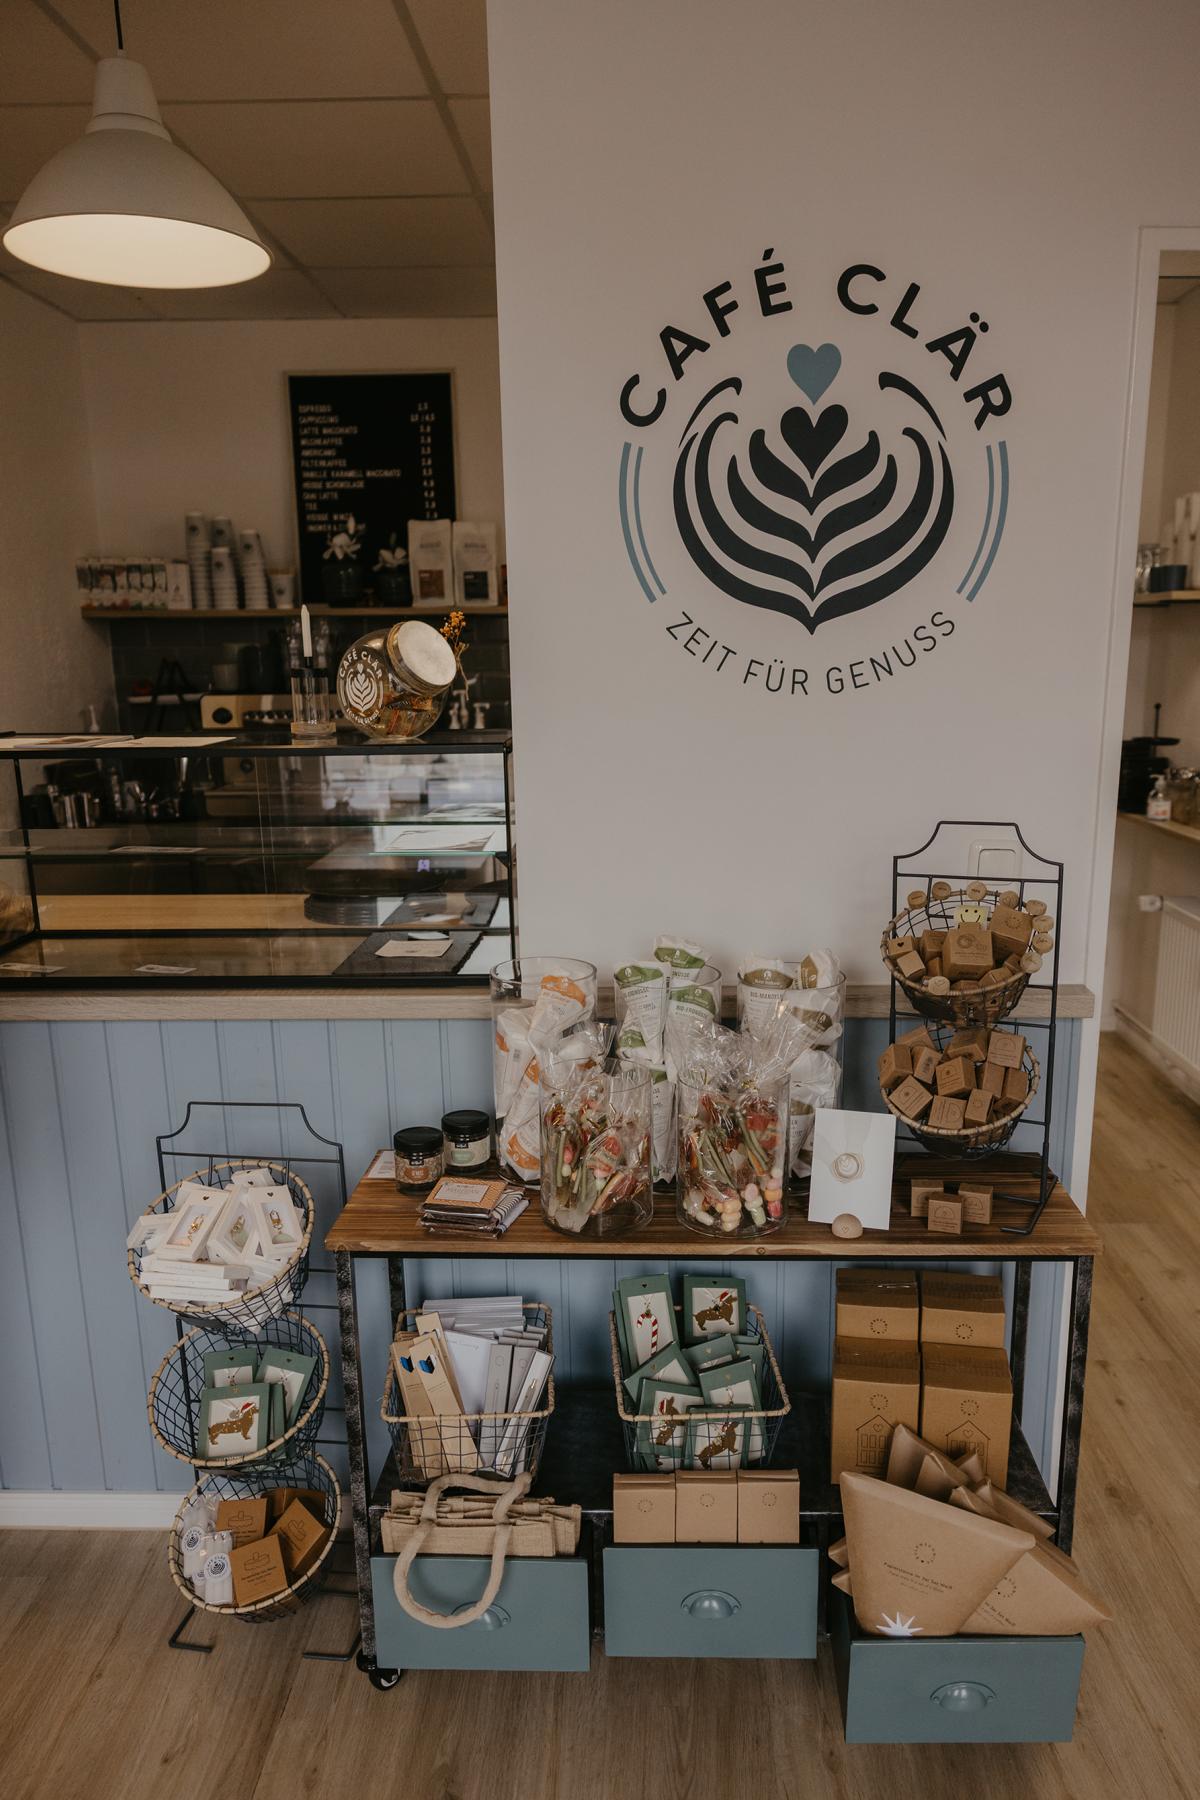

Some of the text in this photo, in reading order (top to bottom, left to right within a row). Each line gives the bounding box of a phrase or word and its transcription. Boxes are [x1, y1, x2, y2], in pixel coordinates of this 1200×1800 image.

[619, 247, 1013, 431] CAFÉ CLÄR
[339, 648, 358, 678] CAFÉ
[665, 610, 956, 696] ZEIT FÜR GENUSS
